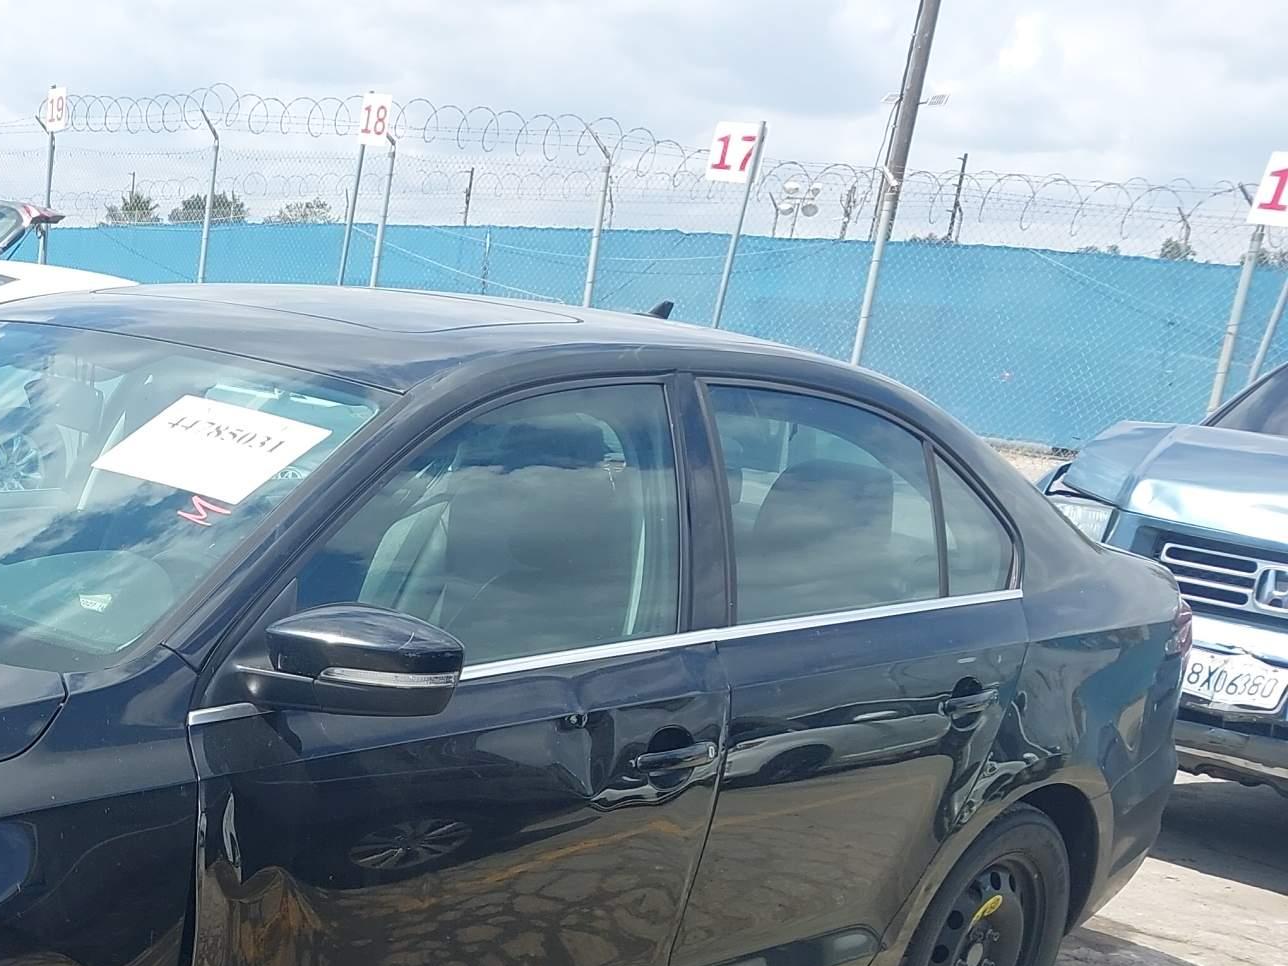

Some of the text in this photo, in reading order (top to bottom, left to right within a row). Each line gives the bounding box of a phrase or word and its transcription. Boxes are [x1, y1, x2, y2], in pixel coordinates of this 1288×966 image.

[48, 95, 64, 122] 19
[361, 104, 388, 136] 18
[711, 134, 757, 172] 17
[168, 416, 285, 453] 44785031
[1187, 662, 1279, 698] 8X06380
